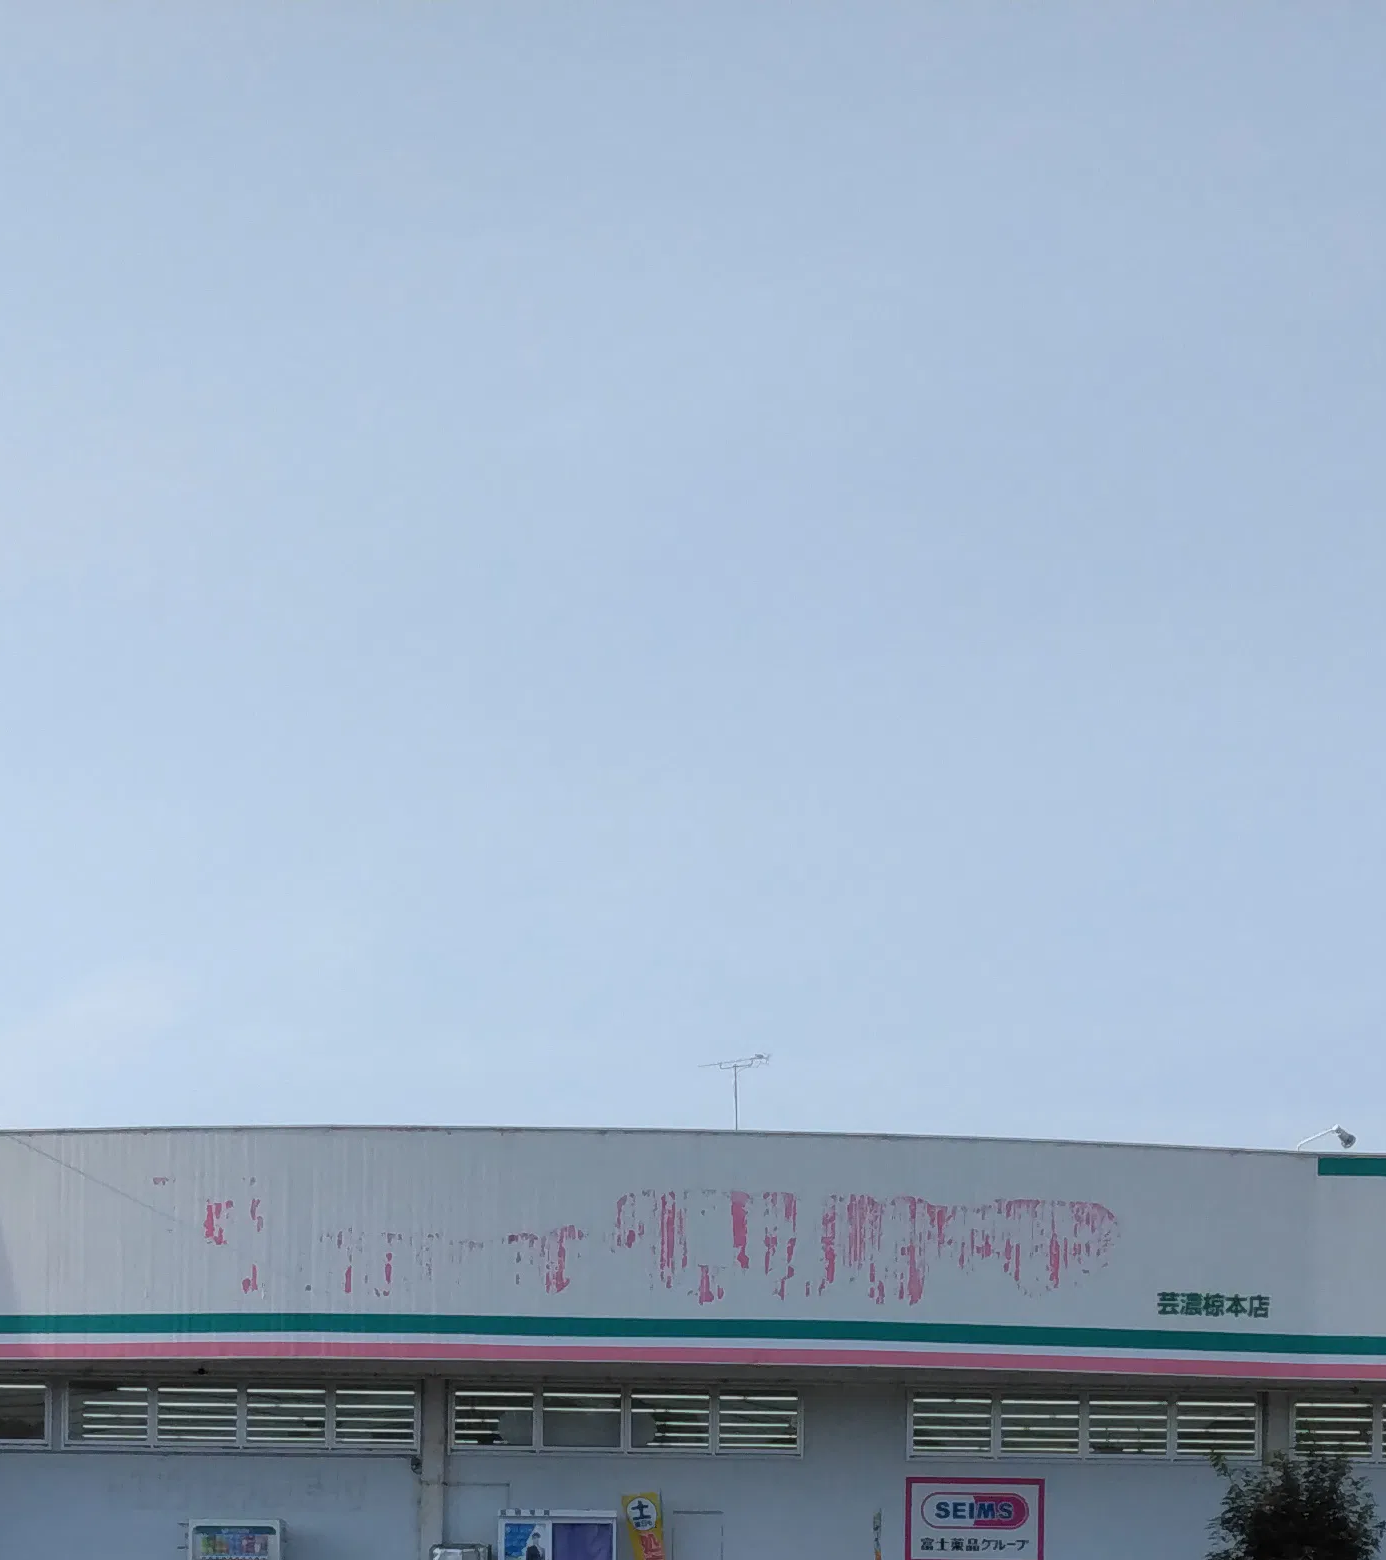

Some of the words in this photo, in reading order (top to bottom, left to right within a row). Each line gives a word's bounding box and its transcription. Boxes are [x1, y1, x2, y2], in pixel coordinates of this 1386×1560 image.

[1156, 1291, 1270, 1319] 芸濃椋本店
[630, 1500, 653, 1521] 土
[934, 1501, 1013, 1520] SEIMS
[919, 1537, 1029, 1552] 富士薬品グループ
